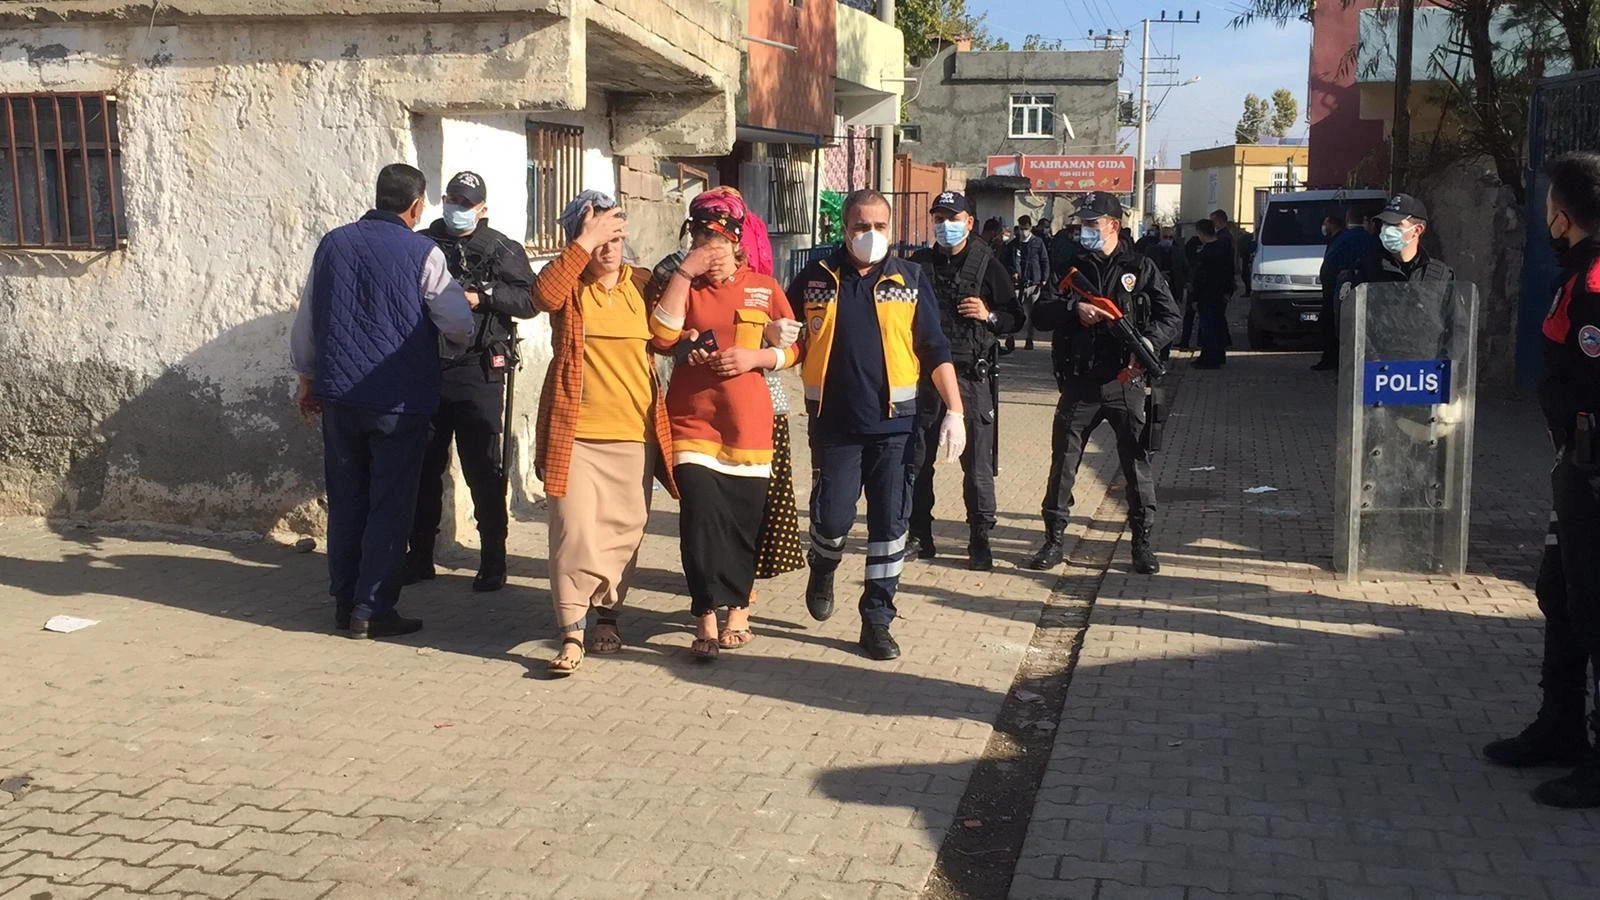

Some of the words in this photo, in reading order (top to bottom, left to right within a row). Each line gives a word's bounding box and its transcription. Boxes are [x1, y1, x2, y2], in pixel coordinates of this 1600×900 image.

[1030, 160, 1095, 169] KAHRAMAN
[1097, 160, 1126, 169] GIDA
[1375, 369, 1438, 392] POLİS
